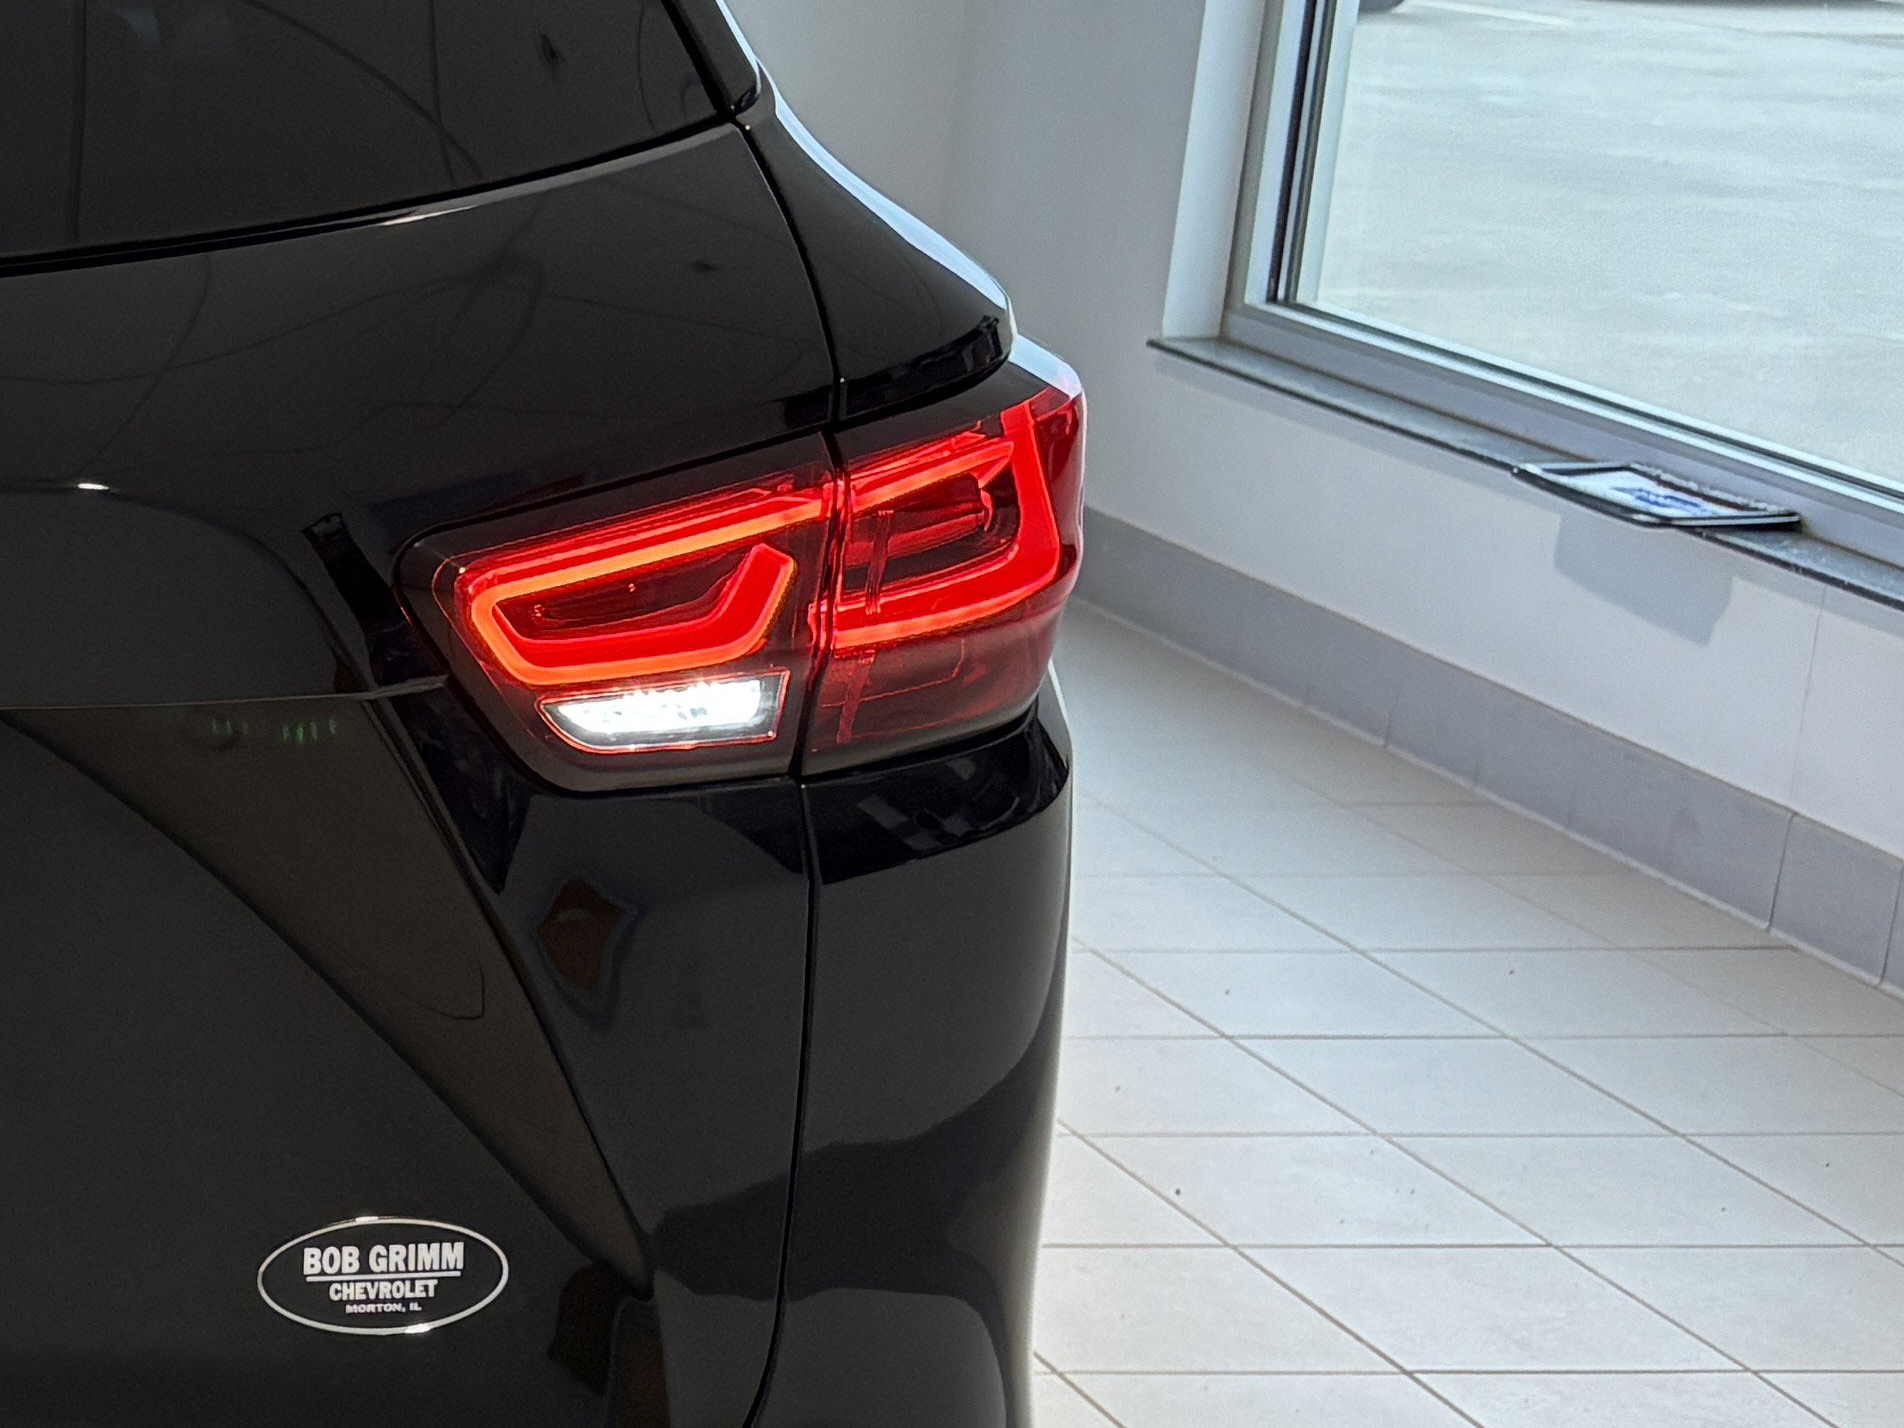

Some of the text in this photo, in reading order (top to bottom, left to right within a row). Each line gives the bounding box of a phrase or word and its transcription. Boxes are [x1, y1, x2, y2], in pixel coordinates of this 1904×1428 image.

[303, 1241, 465, 1276] BOB GRIMM
[328, 1278, 439, 1302] CHEVROLET
